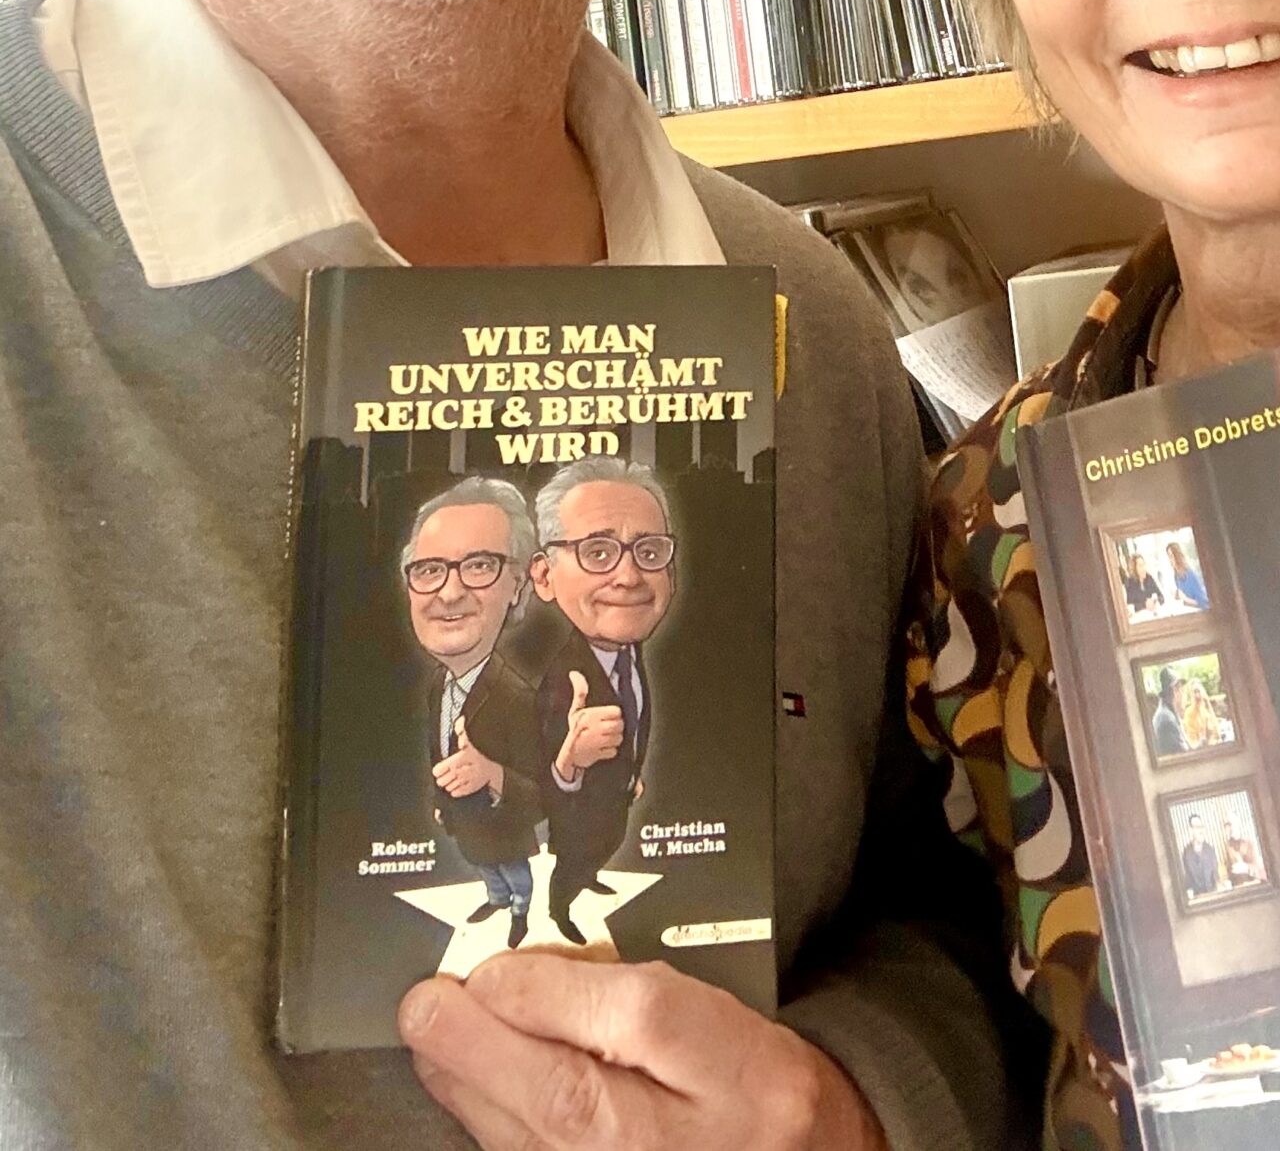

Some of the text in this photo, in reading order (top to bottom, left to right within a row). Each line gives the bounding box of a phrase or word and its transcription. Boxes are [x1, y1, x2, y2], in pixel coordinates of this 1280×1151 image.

[462, 324, 656, 357] WIE MAN
[388, 352, 723, 395] UNVERSCHÄMT
[354, 387, 753, 433] REICH & BERÜHMT
[495, 430, 620, 465] WIRD
[1084, 432, 1190, 484] Christine
[640, 821, 726, 840] Christian
[371, 839, 436, 857] Robert
[640, 838, 726, 858] W. Mucha
[358, 858, 436, 876] Sommer
